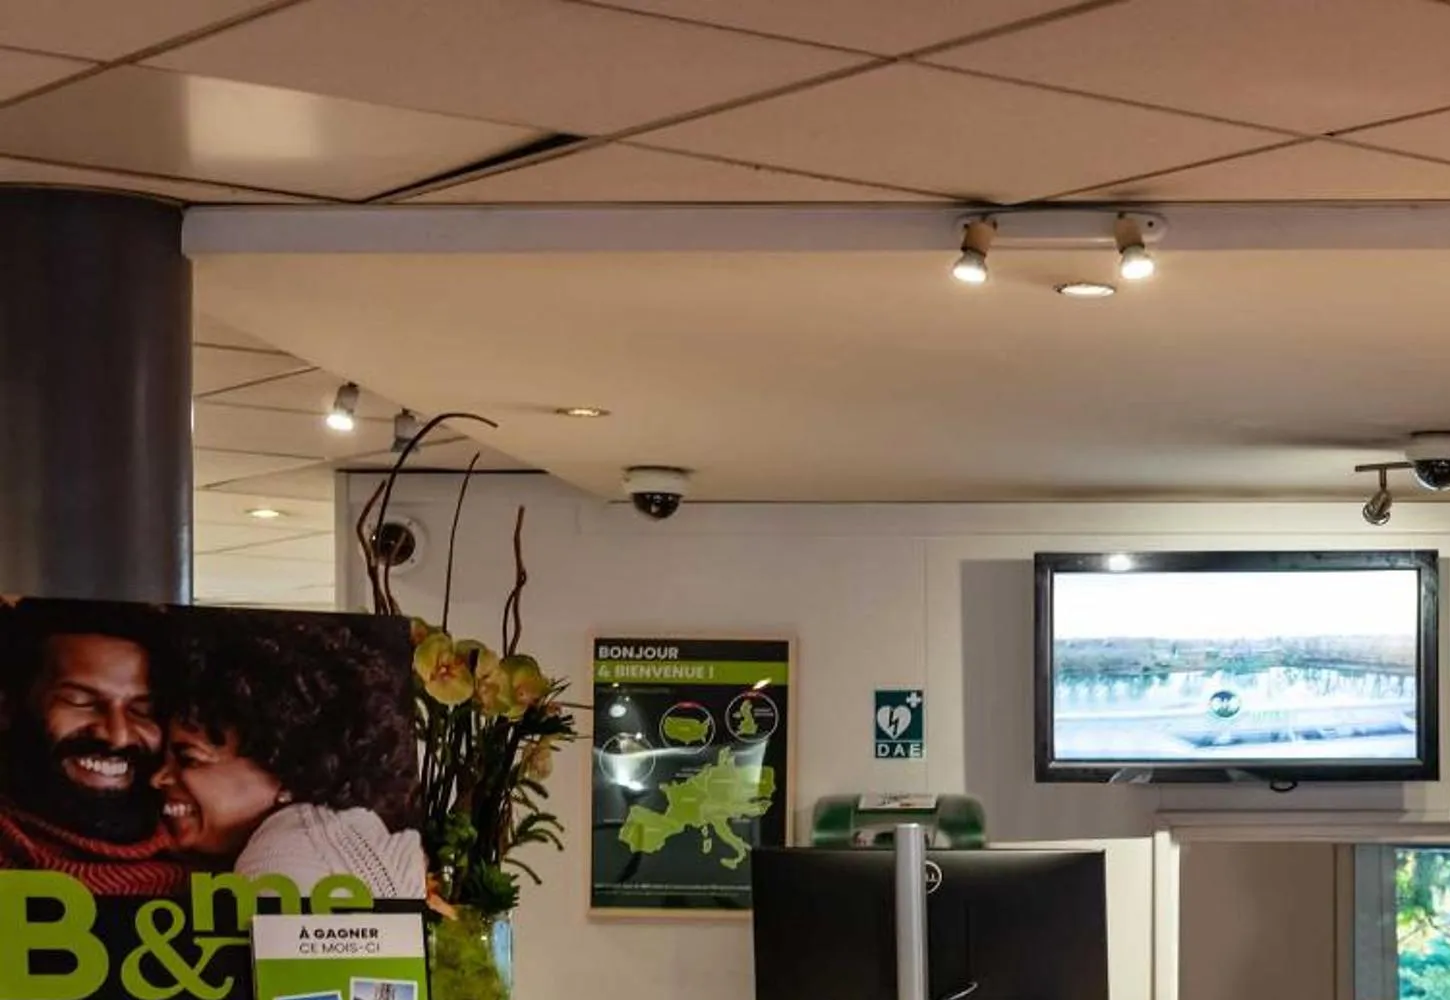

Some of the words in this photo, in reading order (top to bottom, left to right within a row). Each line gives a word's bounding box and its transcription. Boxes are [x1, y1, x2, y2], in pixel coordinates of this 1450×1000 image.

[598, 646, 679, 660] BONJOUR
[598, 665, 609, 677] &
[614, 664, 704, 679] BIENVENUE
[299, 925, 310, 939] À
[314, 927, 379, 939] GAGNER
[299, 942, 319, 954] CE
[322, 942, 381, 954] MOIS-CI
